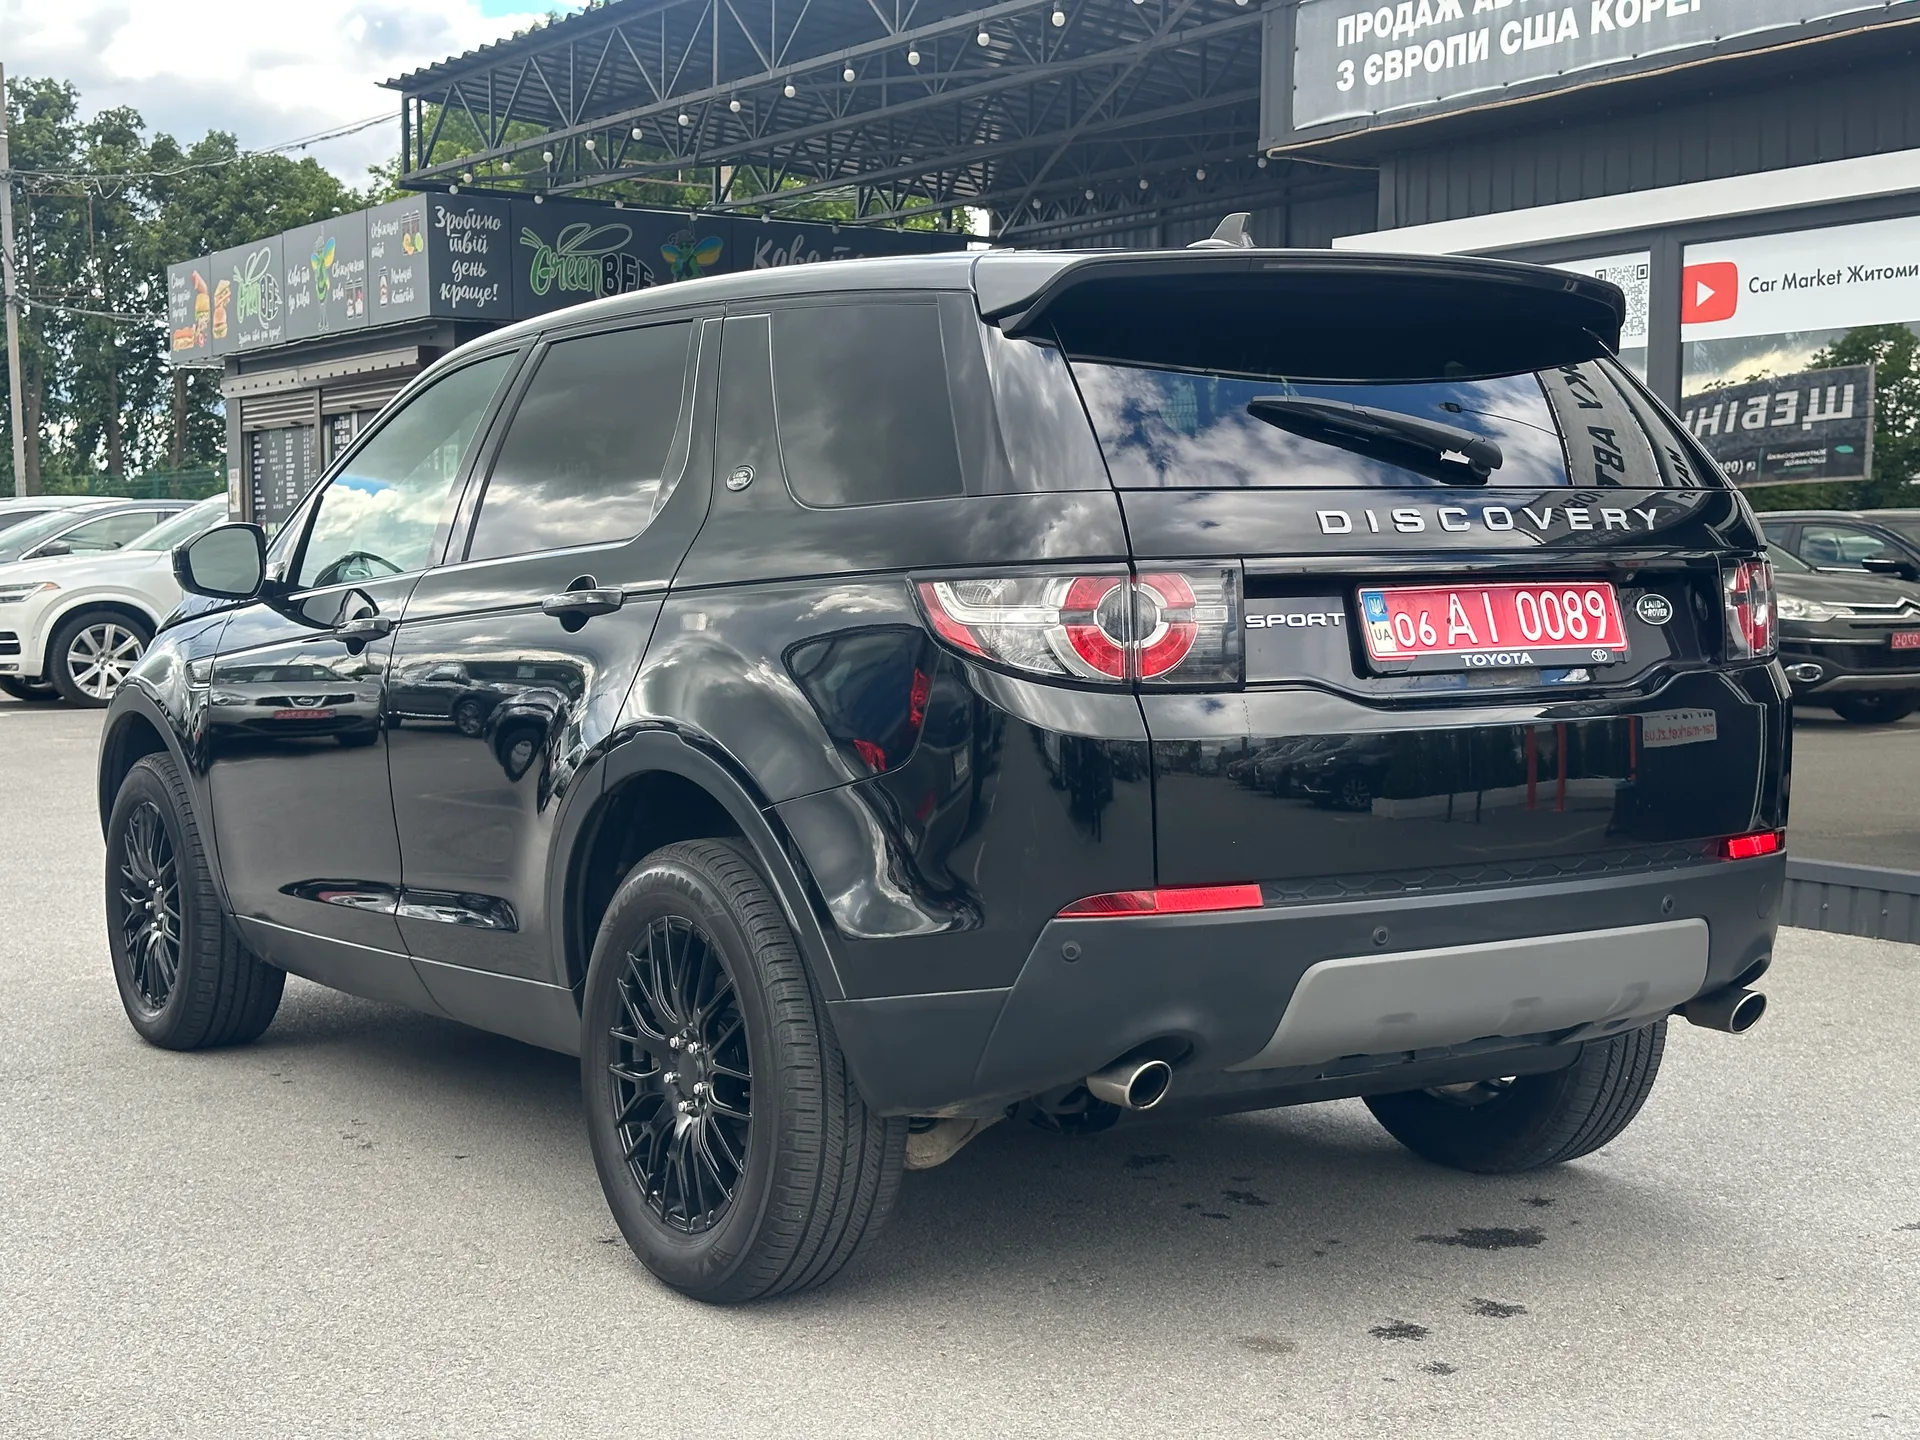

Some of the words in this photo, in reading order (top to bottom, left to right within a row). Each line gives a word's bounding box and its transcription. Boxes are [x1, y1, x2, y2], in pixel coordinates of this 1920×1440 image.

[1336, 0, 1464, 47] ПРОДАЖ
[1336, 59, 1355, 92] З
[1363, 27, 1489, 86] ЄВРОПИ
[1500, 7, 1580, 55] США
[434, 205, 502, 236] Зробимо
[449, 230, 489, 254] твій
[452, 260, 488, 282] день
[1749, 276, 1778, 294] Car
[1782, 268, 1842, 291] Market
[439, 283, 499, 308] краще!
[1315, 506, 1658, 534] DISCOVERY
[1643, 600, 1662, 609] LAND
[1647, 608, 1668, 617] ROVER
[1245, 613, 1345, 629] SPORT
[1393, 611, 1437, 648] 06
[1515, 590, 1607, 641] 0089
[1373, 627, 1393, 641] UA
[1461, 652, 1533, 667] TOYOTA
